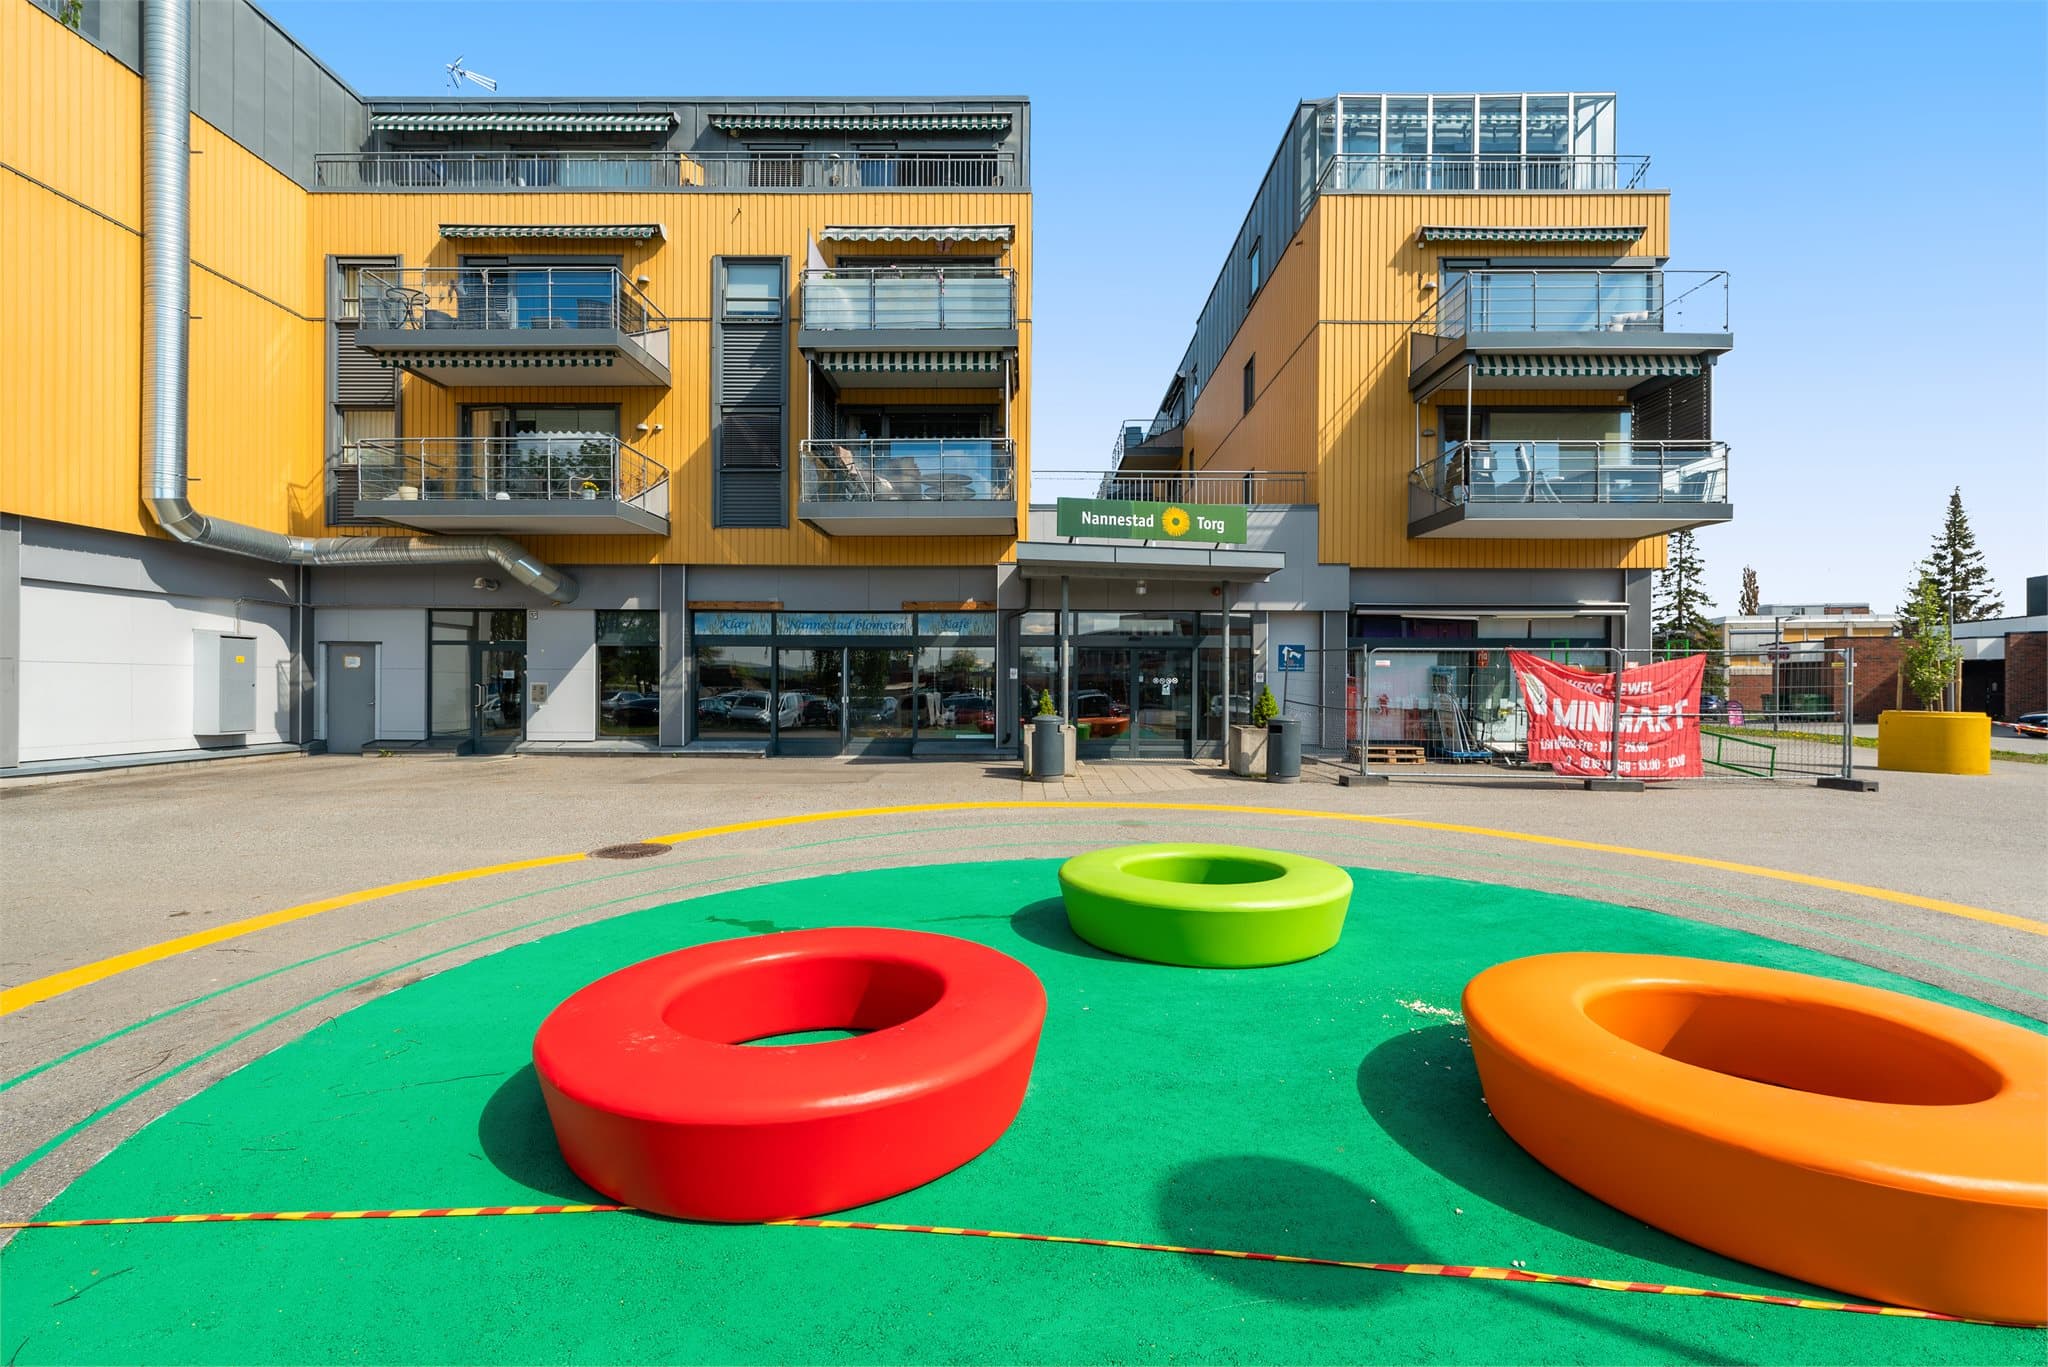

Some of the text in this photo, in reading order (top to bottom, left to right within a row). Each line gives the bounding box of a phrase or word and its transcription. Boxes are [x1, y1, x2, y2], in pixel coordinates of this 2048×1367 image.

[1081, 511, 1225, 534] Nannestad Torg
[787, 619, 907, 632] Nannestad blomster
